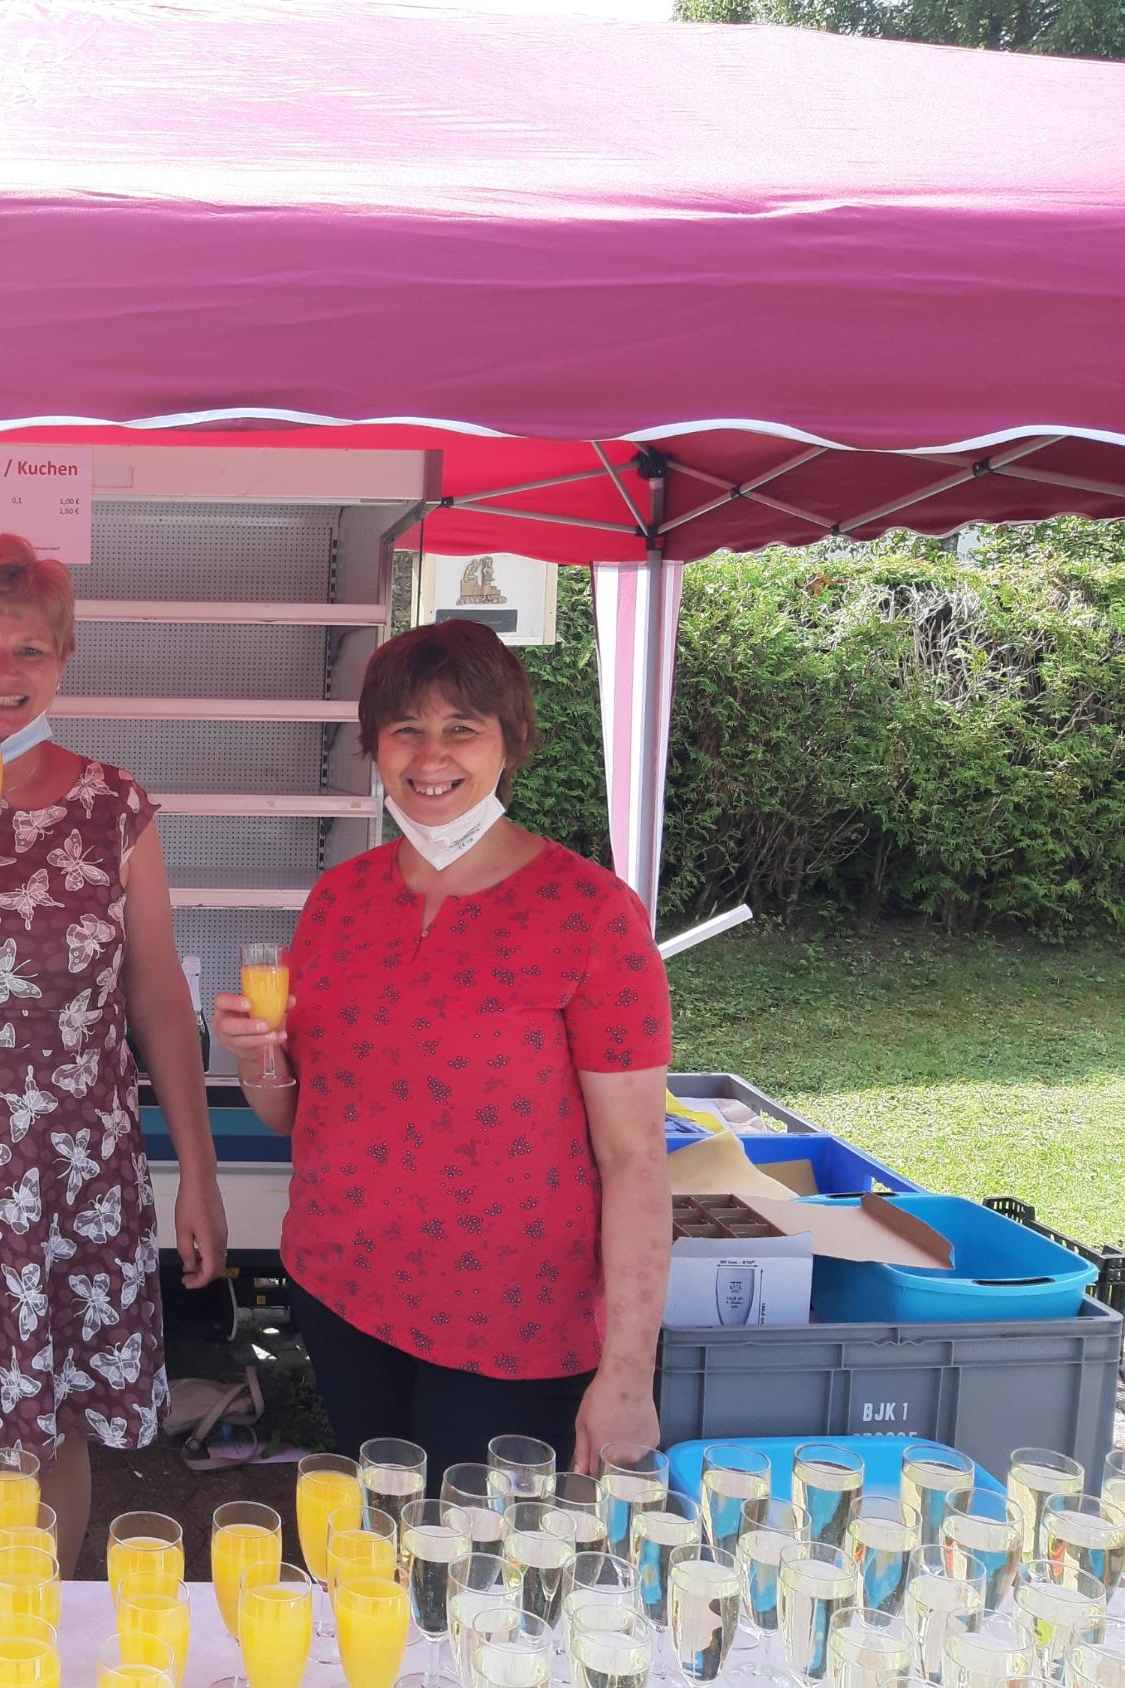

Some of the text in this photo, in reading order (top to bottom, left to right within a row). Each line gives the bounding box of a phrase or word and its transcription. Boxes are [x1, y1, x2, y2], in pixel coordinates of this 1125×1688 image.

[4, 459, 13, 477] /
[17, 460, 78, 476] Kuchen
[60, 498, 74, 506] 1,00
[59, 507, 74, 515] 1,50
[862, 1402, 909, 1422] BJK 1
